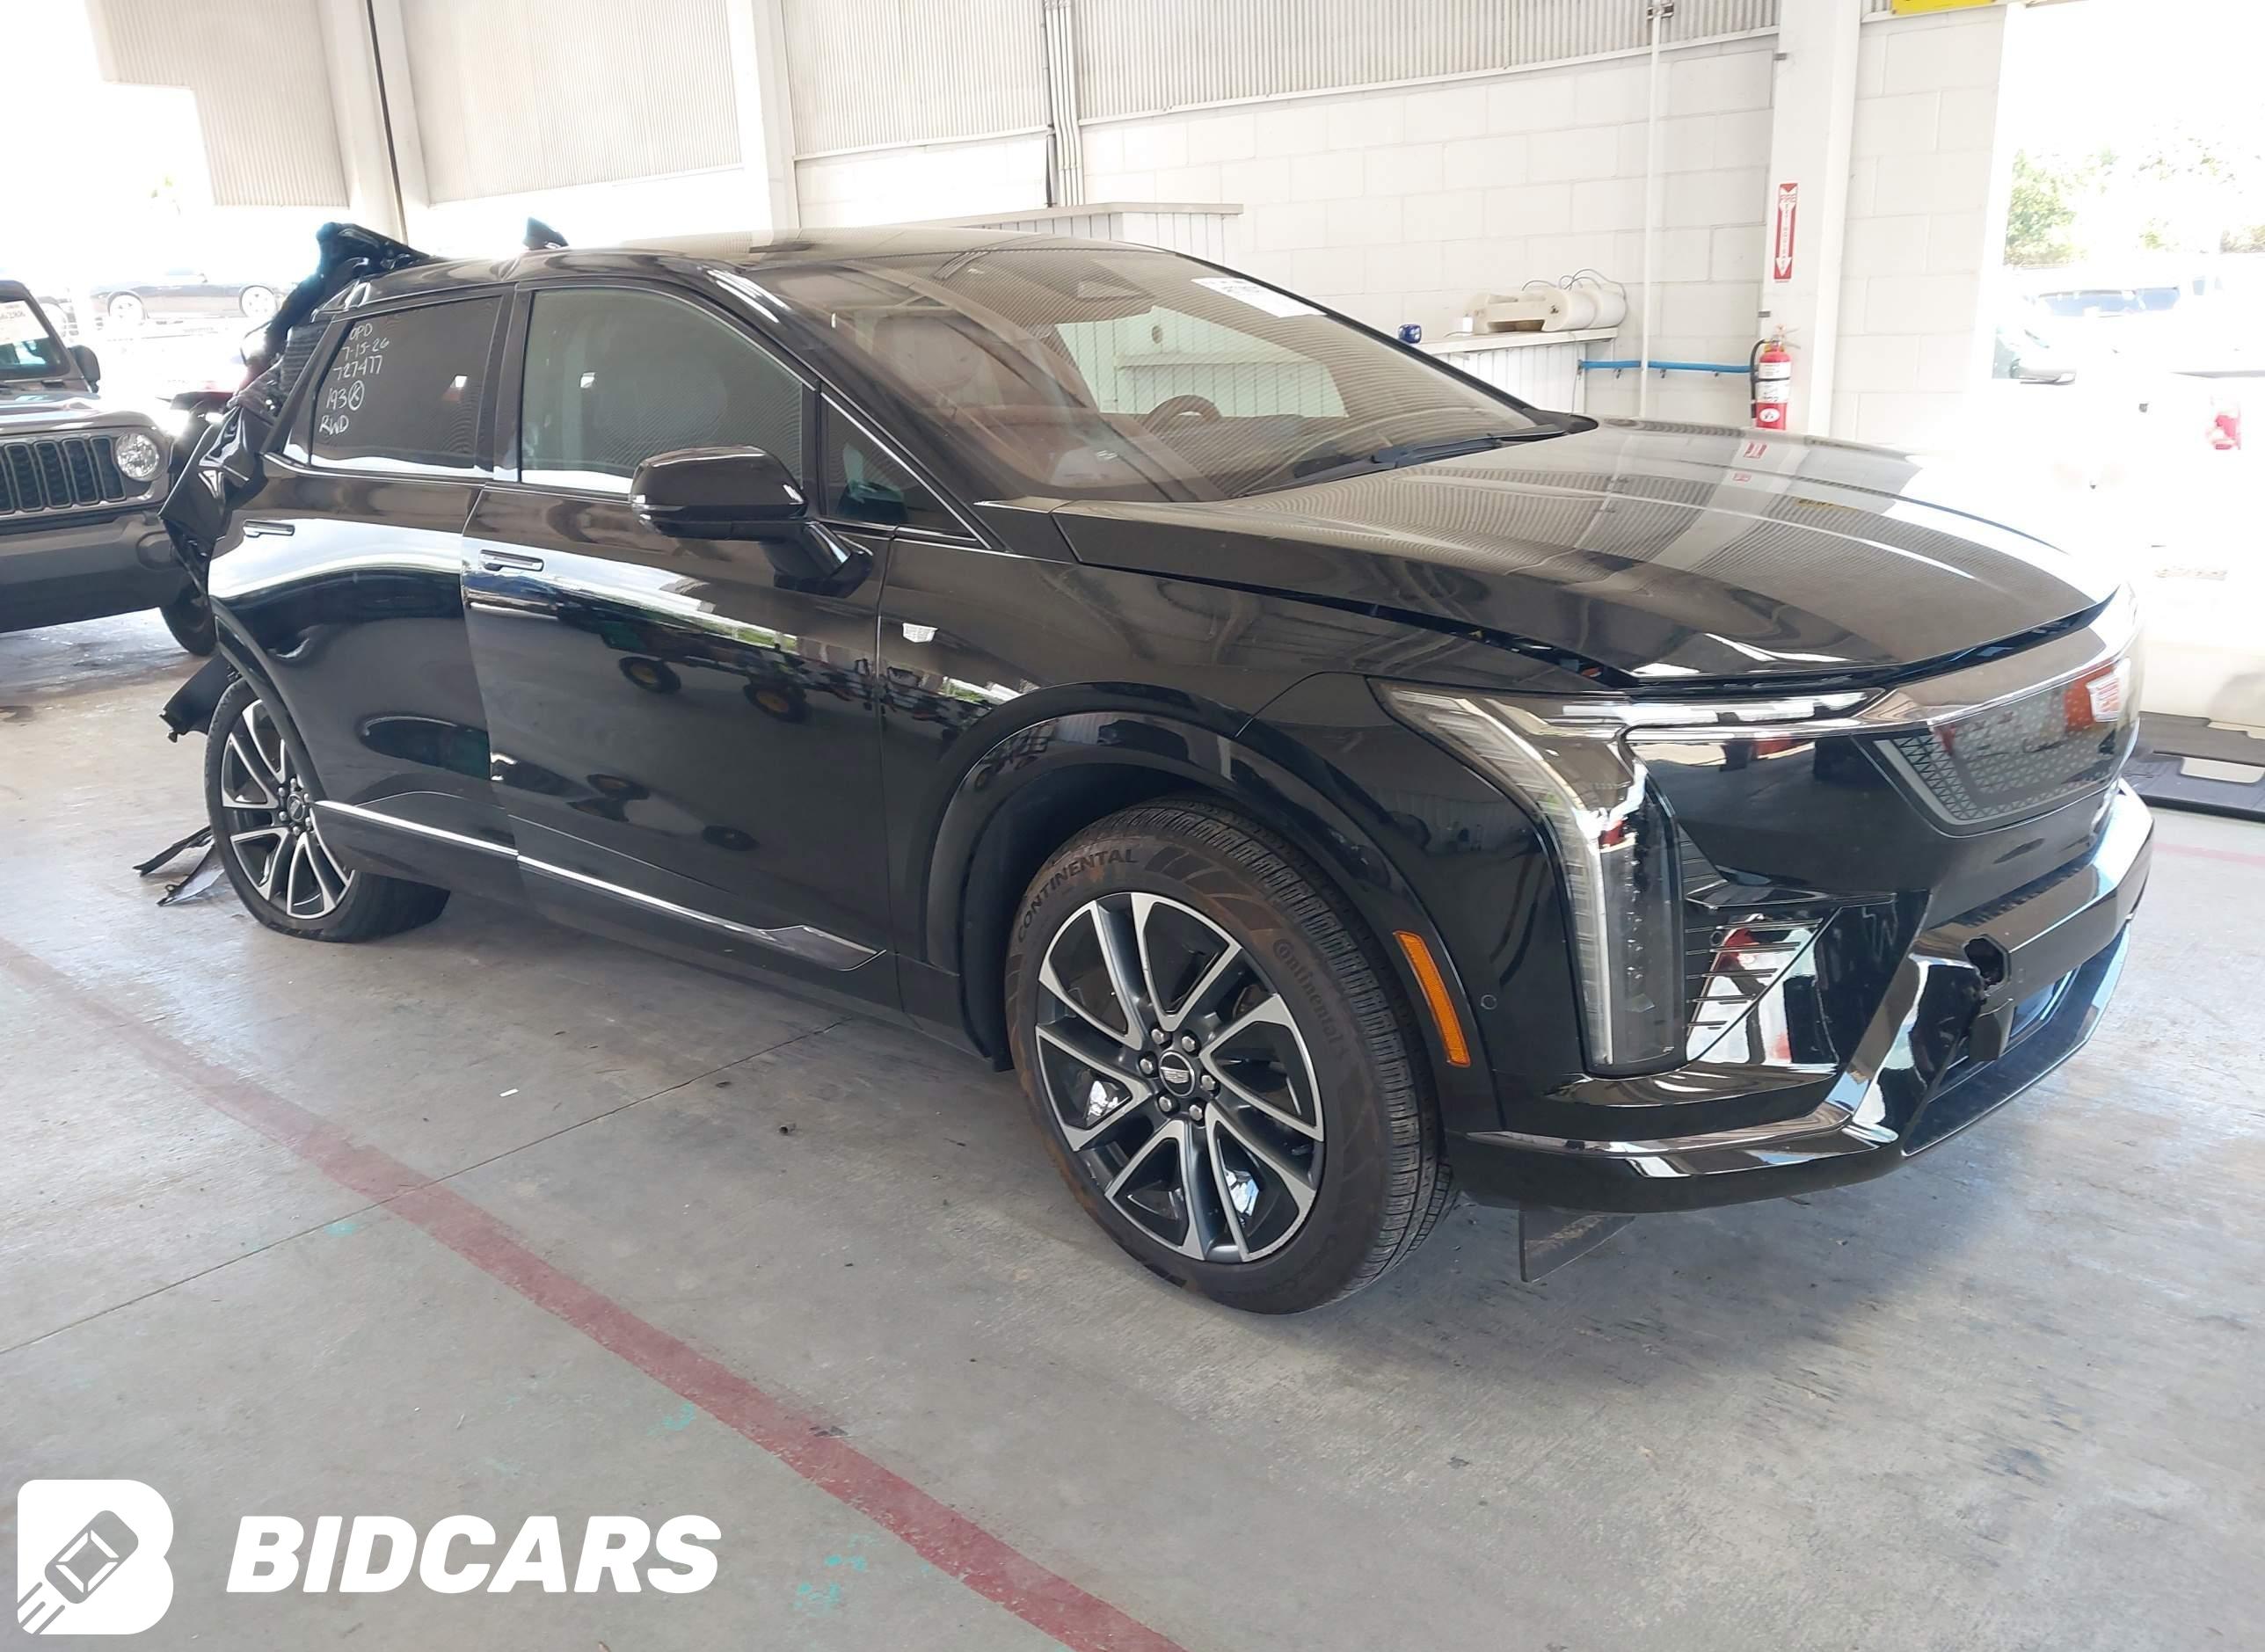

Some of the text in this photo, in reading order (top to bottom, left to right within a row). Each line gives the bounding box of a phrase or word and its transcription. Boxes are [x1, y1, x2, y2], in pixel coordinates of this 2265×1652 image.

[342, 338, 390, 361] 7-15-26
[319, 415, 349, 435] RWD
[1018, 848, 1140, 942] CONTINENTAL
